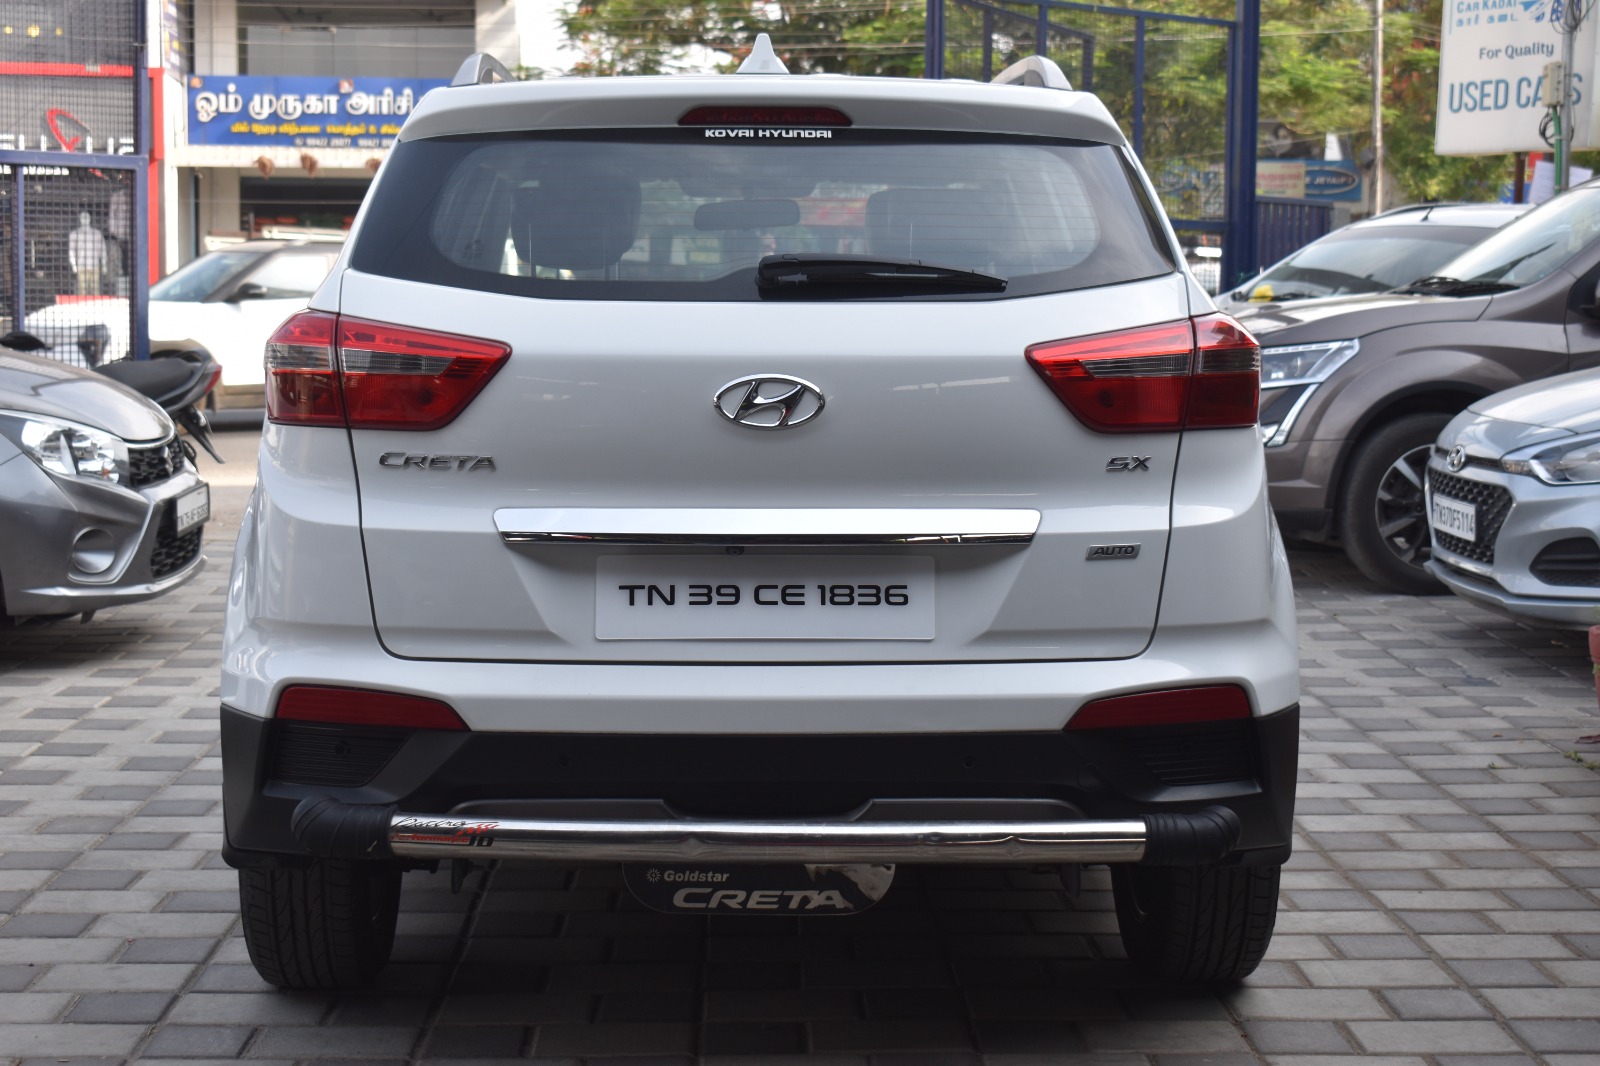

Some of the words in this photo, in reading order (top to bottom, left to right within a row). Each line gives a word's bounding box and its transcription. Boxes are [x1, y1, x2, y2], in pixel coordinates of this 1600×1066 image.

[1479, 48, 1502, 60] For
[1505, 42, 1555, 60] Quality
[195, 82, 243, 123] ஓம்
[248, 92, 340, 120] முருகா
[345, 86, 415, 116] அரிசி
[1449, 79, 1509, 114] USED
[1515, 73, 1583, 109] CAS
[705, 129, 754, 138] KOVAI
[758, 129, 832, 139] HYUNDAI
[379, 452, 497, 472] CRETA
[1106, 455, 1152, 472] SX
[1092, 545, 1135, 556] AUTO
[619, 584, 676, 606] TN
[688, 584, 741, 606] 39
[753, 584, 806, 606] CE
[817, 584, 909, 606] 1836
[663, 869, 730, 882] Goldstar
[672, 887, 850, 909] CRETA
